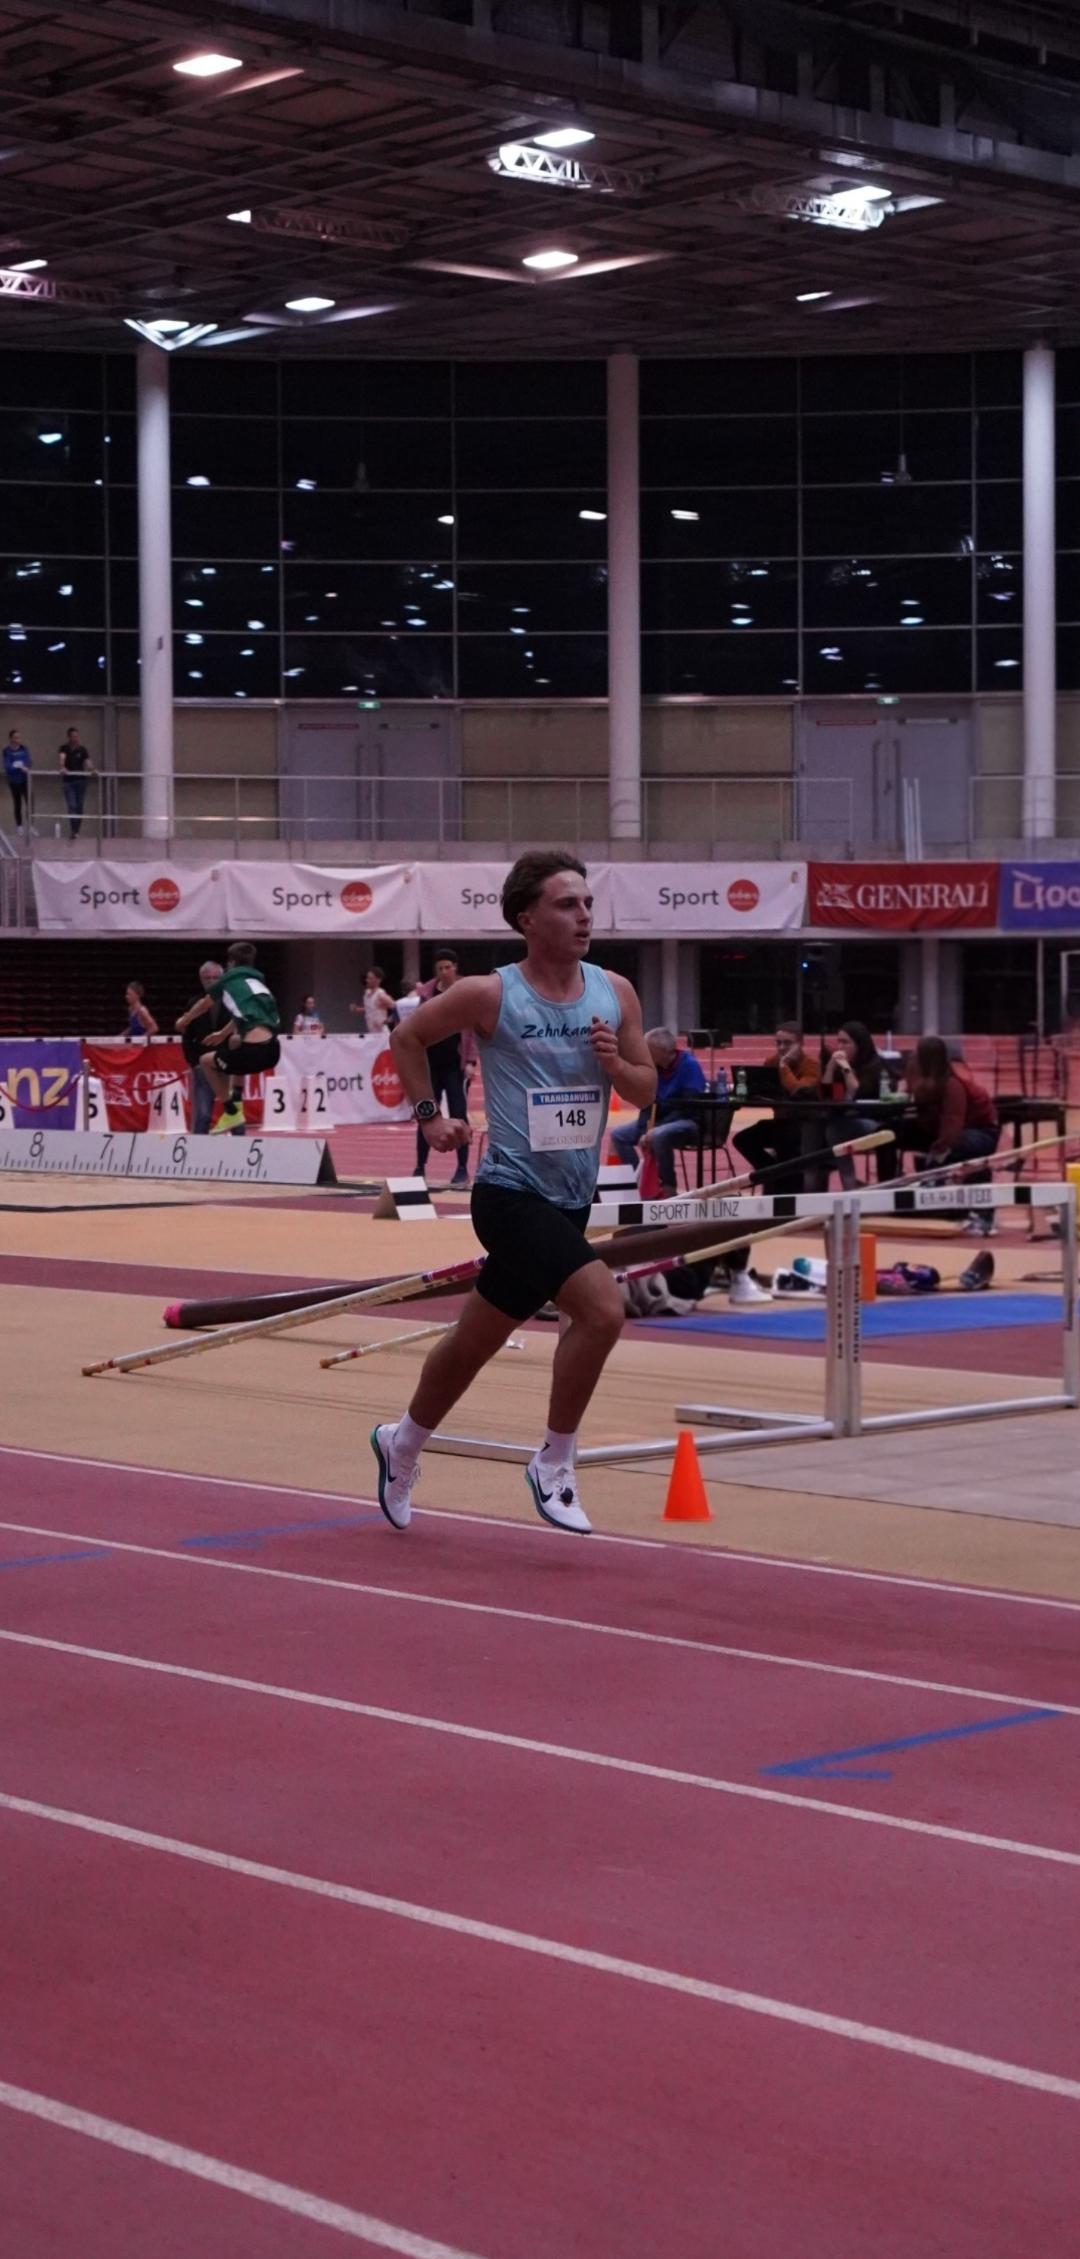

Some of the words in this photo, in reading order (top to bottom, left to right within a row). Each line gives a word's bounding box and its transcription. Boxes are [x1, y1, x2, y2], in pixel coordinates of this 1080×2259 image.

[80, 885, 140, 909] Sport
[272, 887, 332, 910] Sport
[461, 889, 503, 909] Spo
[658, 887, 719, 910] Sport
[521, 1021, 608, 1039] Zehnkam
[170, 1090, 180, 1116] 4
[272, 1088, 286, 1113] 3
[314, 1087, 326, 1112] 2
[555, 1109, 586, 1127] 148
[29, 1131, 44, 1158] 8
[99, 1134, 114, 1160] 7
[172, 1136, 187, 1164] 6
[247, 1139, 263, 1166] 5
[650, 1203, 690, 1221] SPORT
[695, 1202, 708, 1218] IN
[712, 1201, 740, 1217] LINZ
